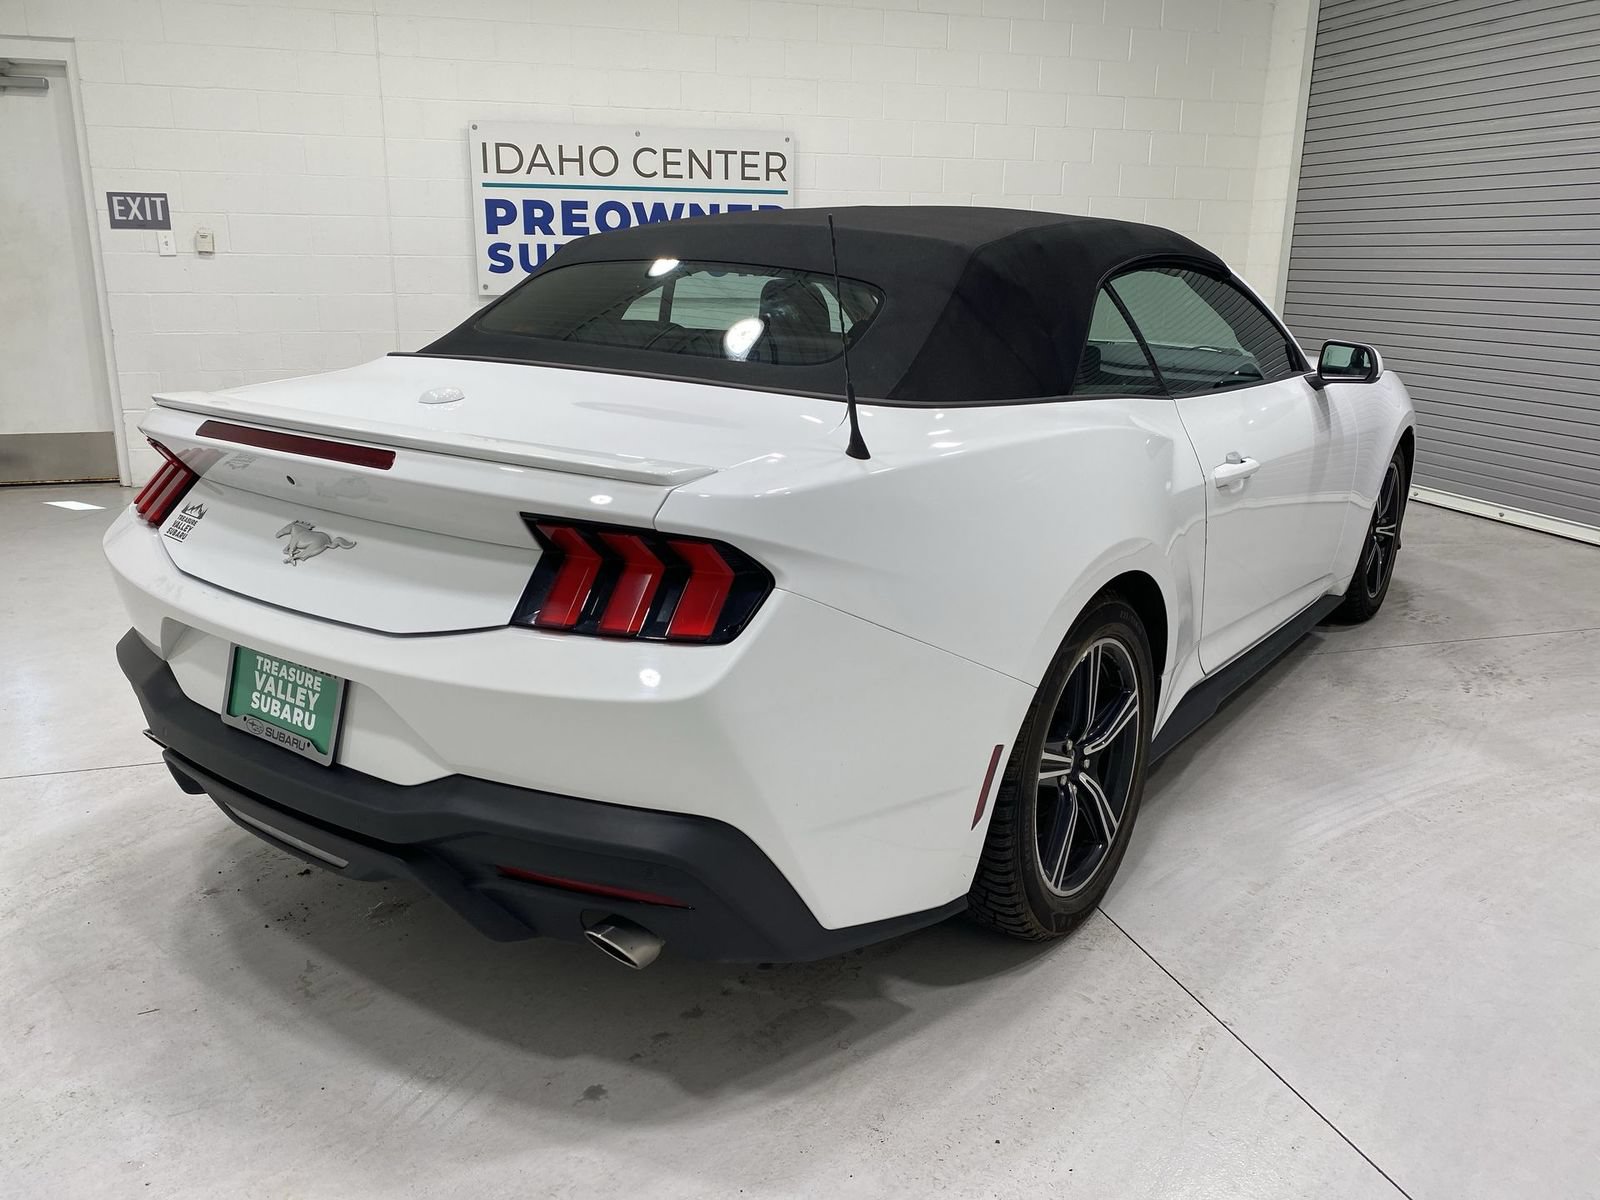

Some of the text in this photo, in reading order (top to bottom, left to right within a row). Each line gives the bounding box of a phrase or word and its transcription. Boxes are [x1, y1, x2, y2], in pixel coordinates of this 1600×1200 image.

[481, 141, 788, 182] IDAHO CENTER
[111, 196, 166, 221] EXIT
[484, 198, 785, 236] PREOW
[487, 242, 565, 274] SU
[166, 527, 189, 540] SUBARU
[172, 520, 194, 534] VALLEY
[177, 514, 198, 527] TREASURE
[256, 655, 322, 692] TREASURE
[255, 670, 320, 712] VALLEY
[250, 691, 316, 731] SUBARU
[264, 726, 307, 751] SUBARU
